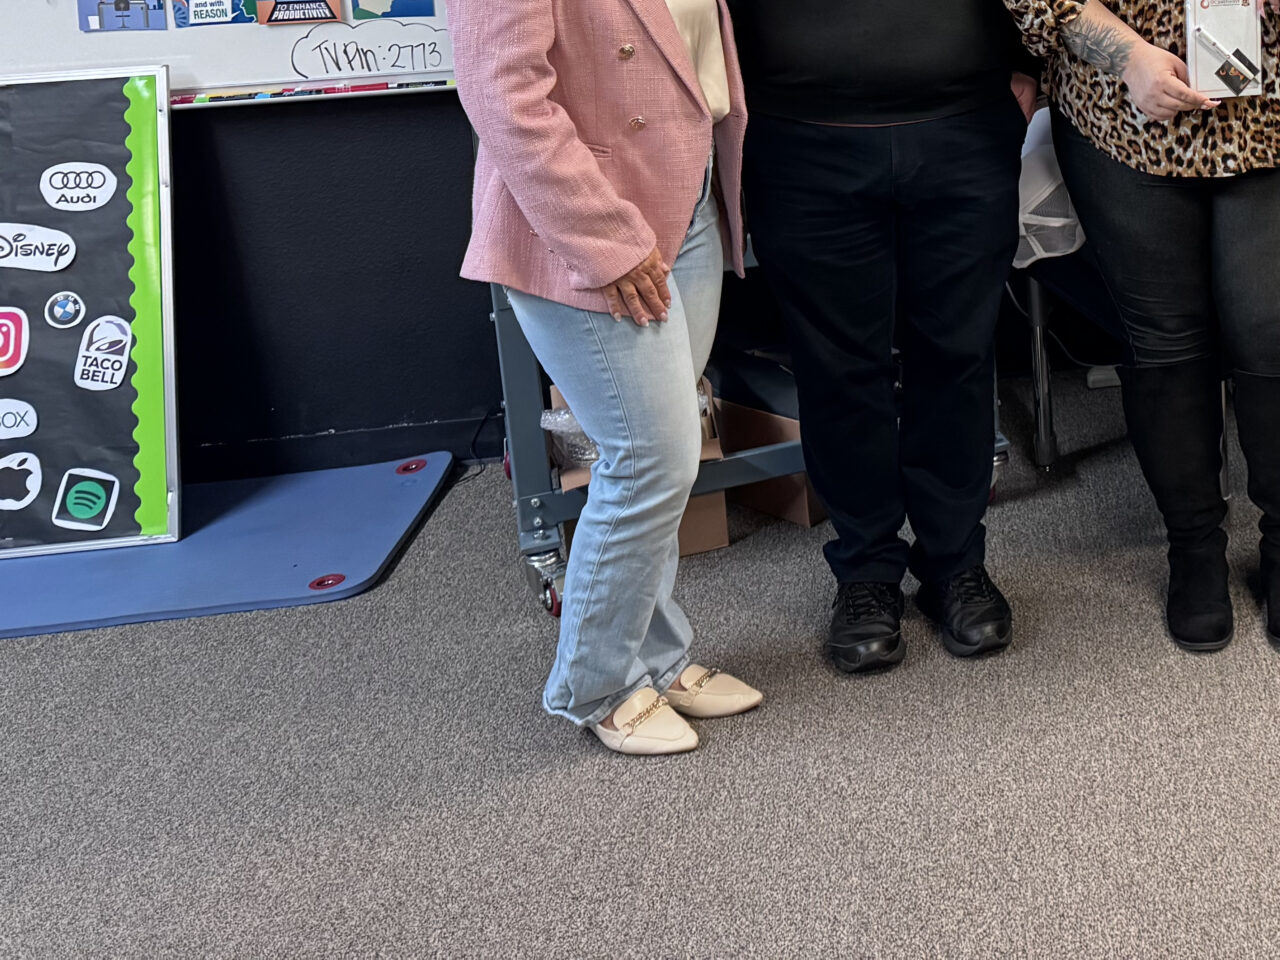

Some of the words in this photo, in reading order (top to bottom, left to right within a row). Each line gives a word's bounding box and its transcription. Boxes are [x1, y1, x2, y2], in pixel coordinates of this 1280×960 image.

[194, 0, 208, 8] and
[193, 8, 228, 19] REASON
[271, 9, 331, 20] PRODUCTIVITY
[312, 40, 342, 74] TV
[388, 42, 442, 71] 2773
[81, 355, 123, 372] TACO
[79, 368, 118, 385] BELL
[0, 410, 30, 429] OX
